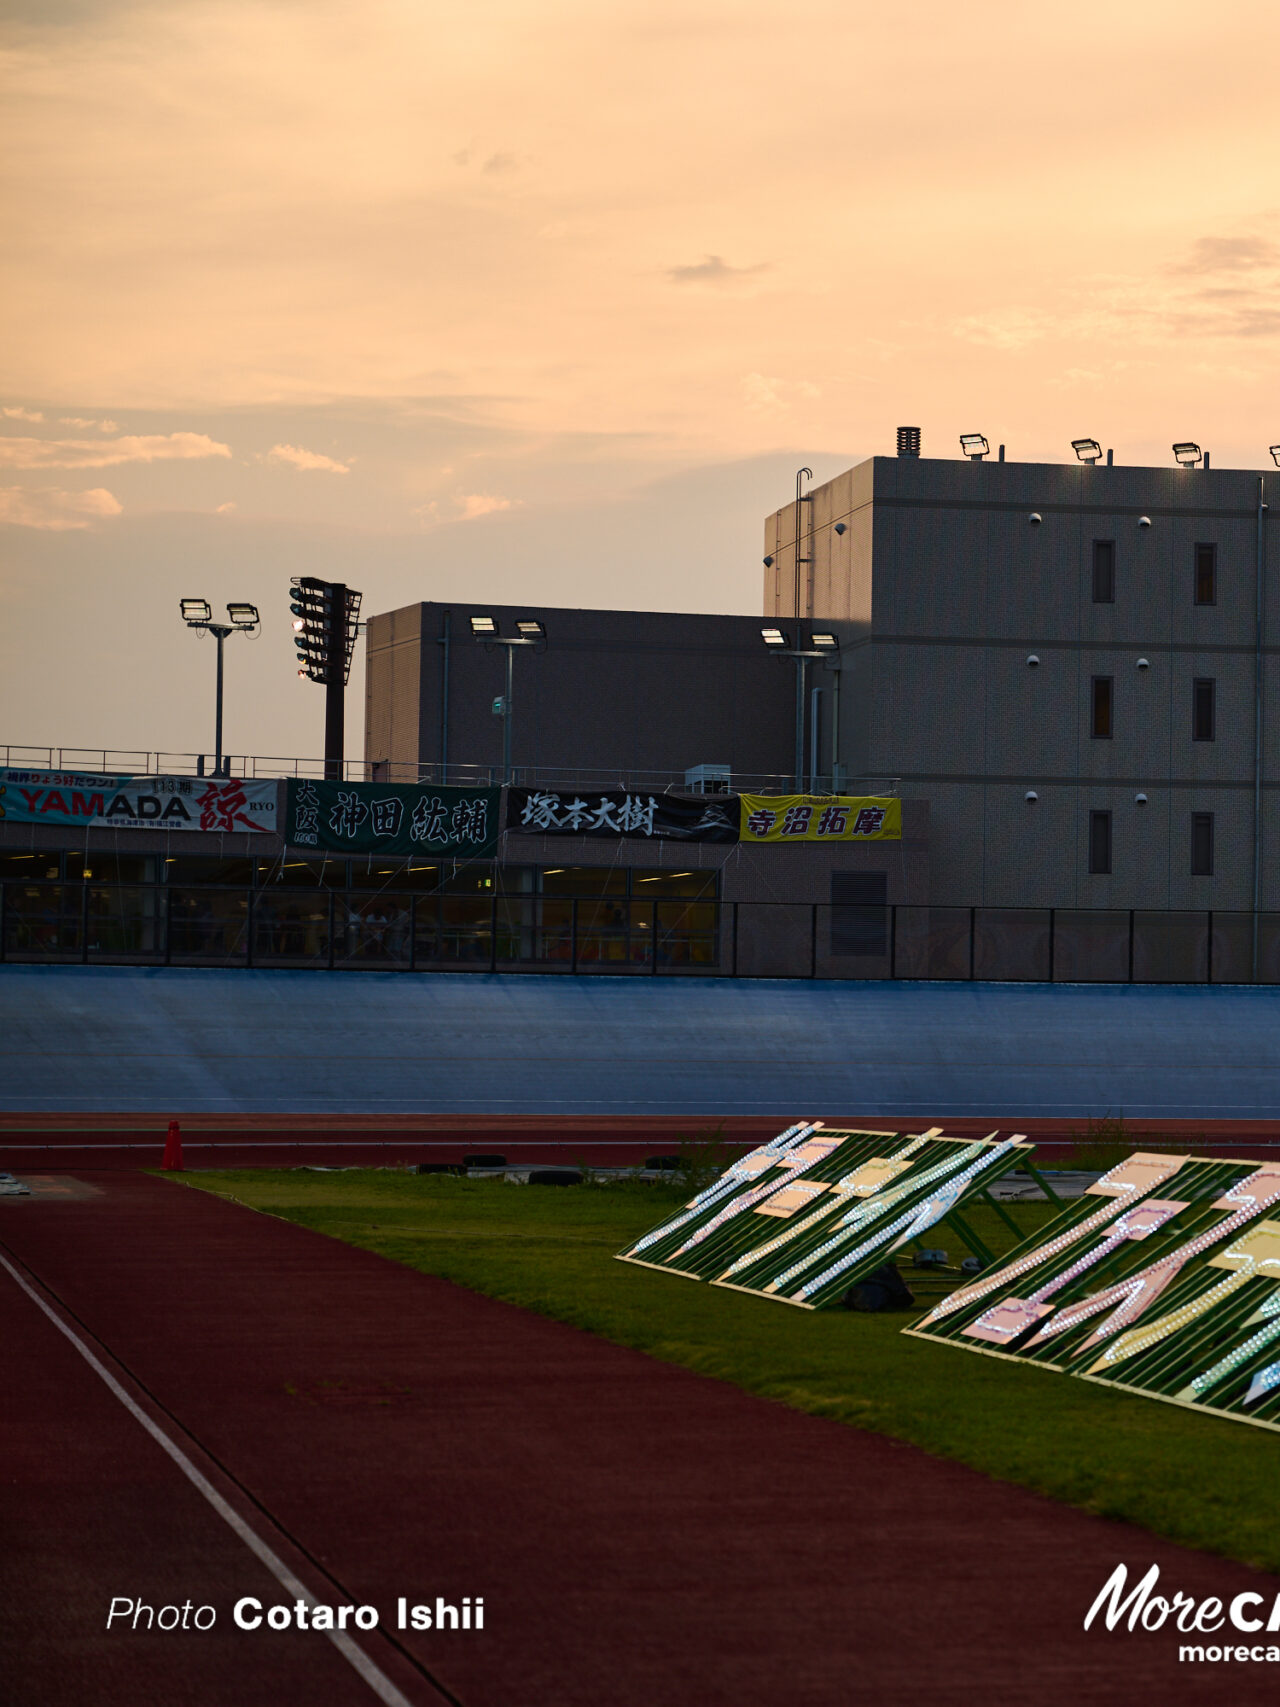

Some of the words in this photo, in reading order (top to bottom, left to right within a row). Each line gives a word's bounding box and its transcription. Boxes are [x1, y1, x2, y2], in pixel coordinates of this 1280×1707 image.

[18, 788, 192, 821] YAMADA
[249, 801, 275, 811] RYO
[295, 778, 320, 833] 大阪
[328, 789, 489, 844] 神田紘輔
[520, 791, 659, 837] 塚本大樹
[746, 805, 887, 837] 寺沼拓摩
